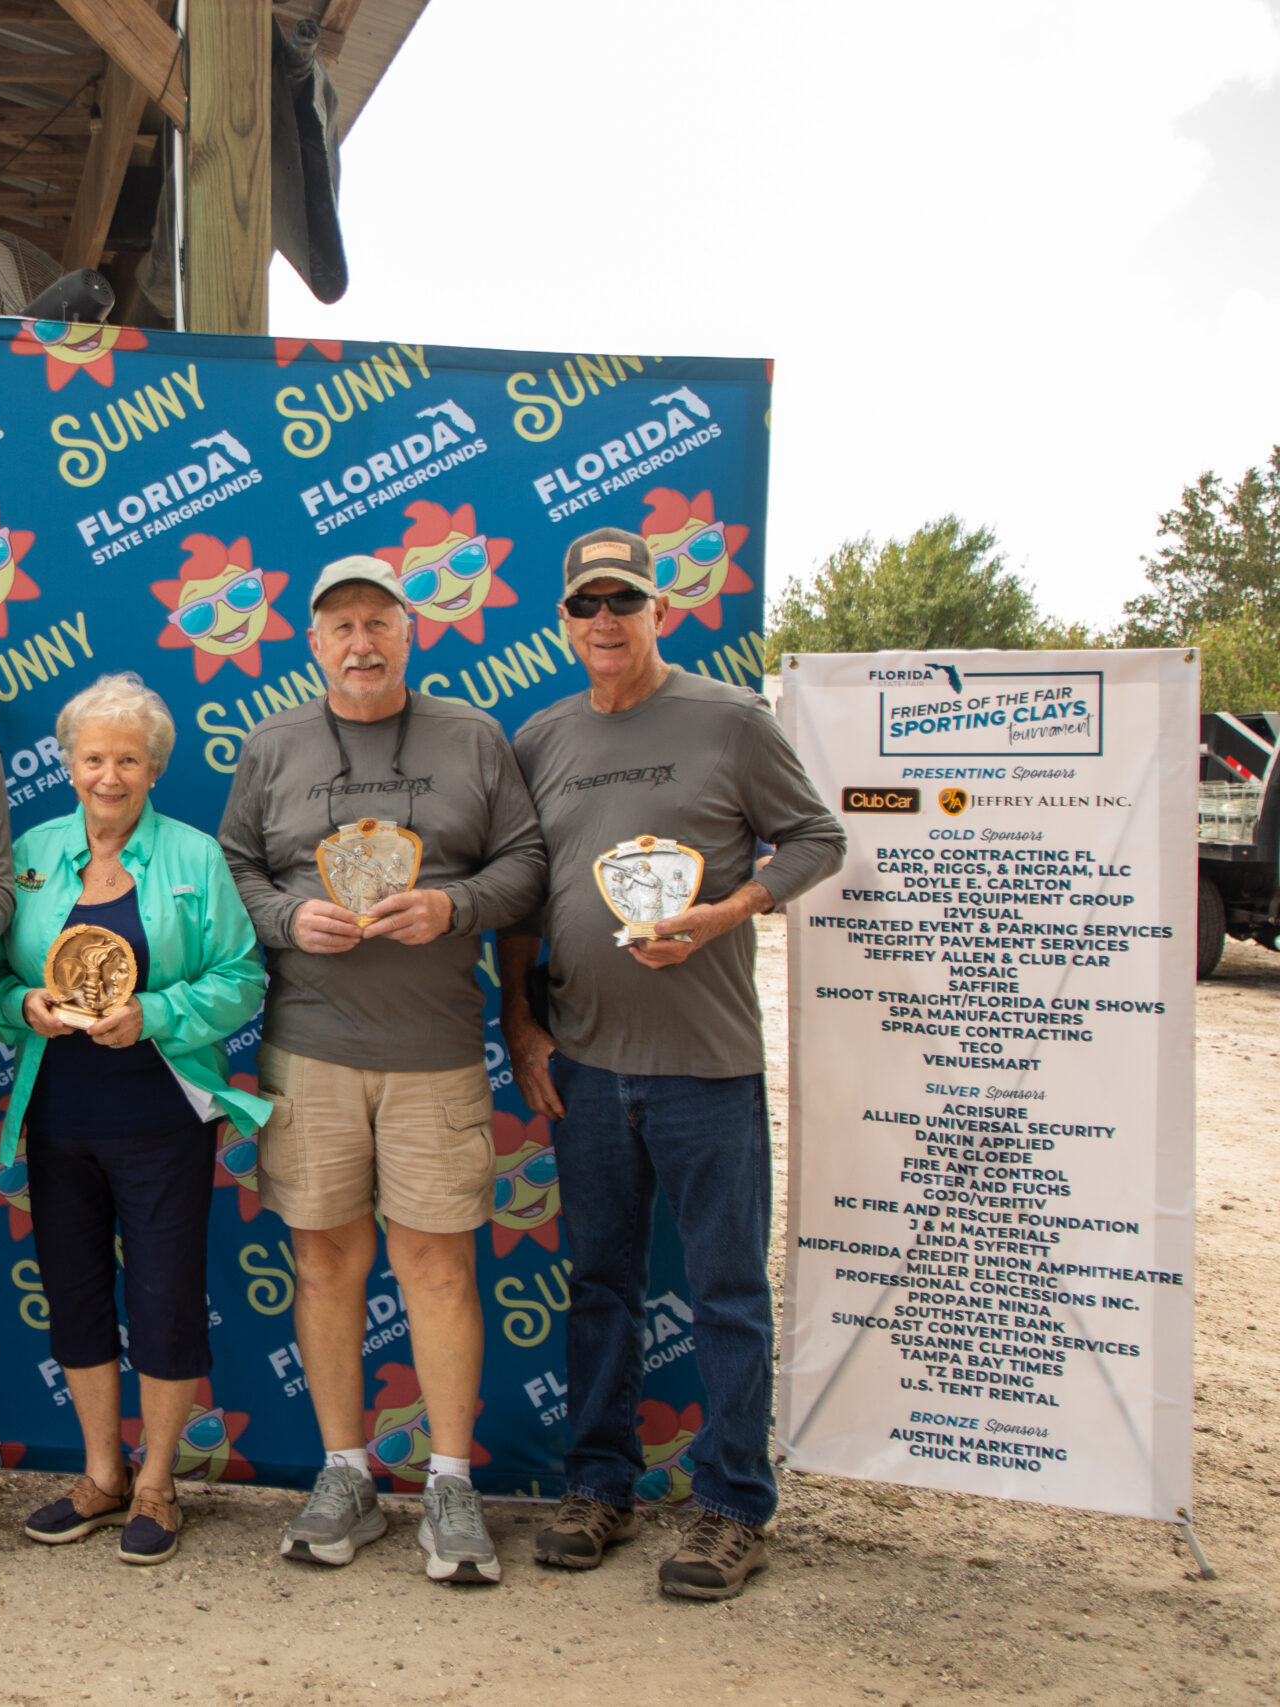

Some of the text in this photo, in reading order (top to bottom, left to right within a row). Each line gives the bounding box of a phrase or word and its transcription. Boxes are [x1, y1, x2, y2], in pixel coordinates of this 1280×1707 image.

[50, 364, 205, 487] SUNNY
[533, 409, 696, 504] FLORIDA
[548, 424, 722, 523] STATE FAIRGROUNDS
[869, 670, 933, 680] FLORIDA
[890, 686, 1073, 720] FRIENDS OF THE FAIR
[890, 700, 1090, 738] SPORTING CLAYS
[1008, 713, 1094, 745] tournament
[902, 766, 1076, 782] PRESENTING Sponsors
[850, 794, 912, 809] Club Car
[928, 828, 1043, 842] GOLD Sponsors
[876, 847, 1096, 863] BAYCO CONTRACTING FL
[876, 861, 1132, 878] CARR, RIGGS, & INGRAM, LLC
[841, 888, 1135, 907] EVERGLADES EQUIPMENT GROUP
[943, 907, 1024, 920] I2VISUAL
[809, 915, 1174, 939] INTEGRATED EVENT & PARKING SERVICES
[815, 986, 874, 1001] SHOOT
[877, 990, 1046, 1010] STRAIGHT/FLORIDA
[1050, 997, 1090, 1011] GUN
[948, 979, 1020, 994] SAFFIRE
[880, 1020, 1093, 1042] SPRAGUE CONTRACTING
[958, 1041, 1004, 1055] TECO
[922, 1053, 1042, 1071] VENUESMART
[925, 1082, 1047, 1102] SILVER Sponsors
[942, 1103, 1028, 1120] ACRISURE
[915, 1129, 1055, 1151] DAIKIN APPLIED
[926, 1144, 1033, 1164] EVE GLOEDE
[900, 1170, 1071, 1197] FOSTER AND FUCHS
[922, 1188, 1047, 1210] GOJO/VERITIV
[915, 1233, 1051, 1258] LINDA SYFRETT
[797, 1234, 1184, 1286] MIDFLORIDA CREDIT UNION AMPHITHEATRE
[835, 1267, 965, 1292] PROFESSIONAL
[969, 1281, 1097, 1307] CONCESSIONS
[894, 1304, 1065, 1334] SOUTHSTATE BANK
[831, 1311, 1141, 1357] SUNCOAST CONVENTION SERVICES
[925, 1364, 1034, 1388] TZ BEDDING
[909, 1411, 1049, 1438] BRONZE Sponsors
[889, 1427, 1067, 1462] AUSTIN MARKETING
[908, 1444, 1042, 1473] CHUCK BRUNO
